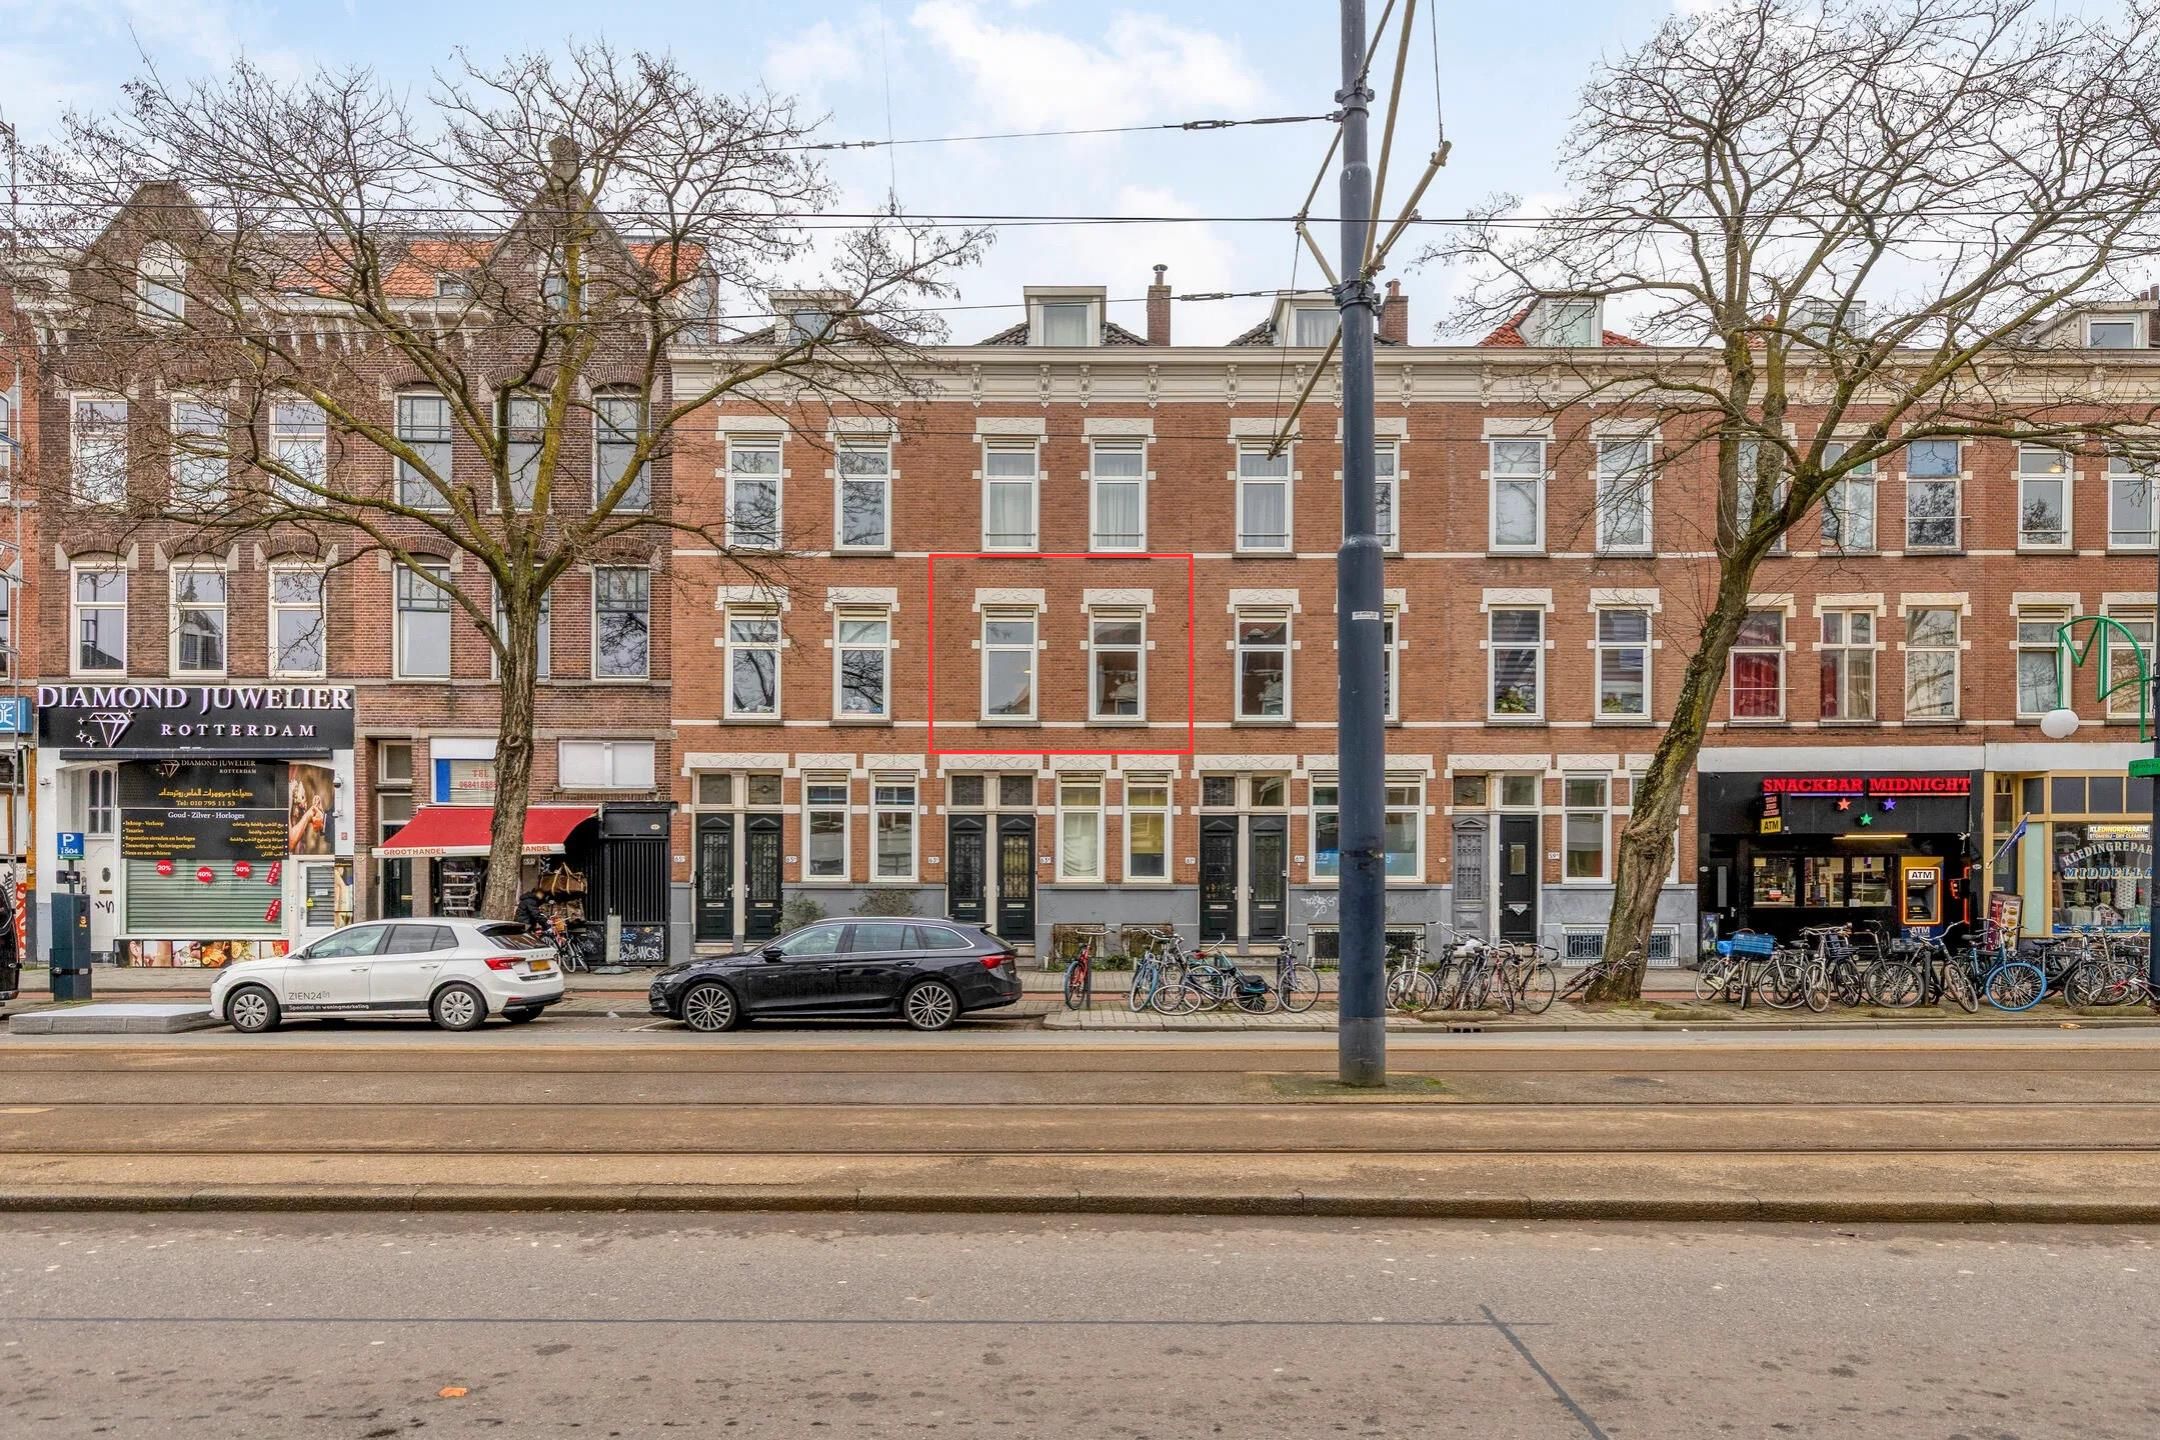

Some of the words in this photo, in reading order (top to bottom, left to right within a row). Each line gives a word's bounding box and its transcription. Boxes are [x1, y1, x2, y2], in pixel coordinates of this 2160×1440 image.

[37, 686, 188, 708] DIAMOND
[200, 687, 353, 715] JUWELIER
[161, 724, 315, 737] ROTTERDAM
[472, 769, 489, 777] TEL
[1763, 778, 1864, 792] SNACKBAR
[1868, 778, 1971, 792] MIDNIGHT
[216, 812, 245, 820] Horloges
[1763, 819, 1779, 832] ATM
[63, 834, 74, 846] P
[384, 848, 447, 856] GROOTHANDEL
[1911, 871, 1932, 879] ATM
[1911, 926, 1931, 934] ATM
[289, 992, 322, 1000] ZIEN24
